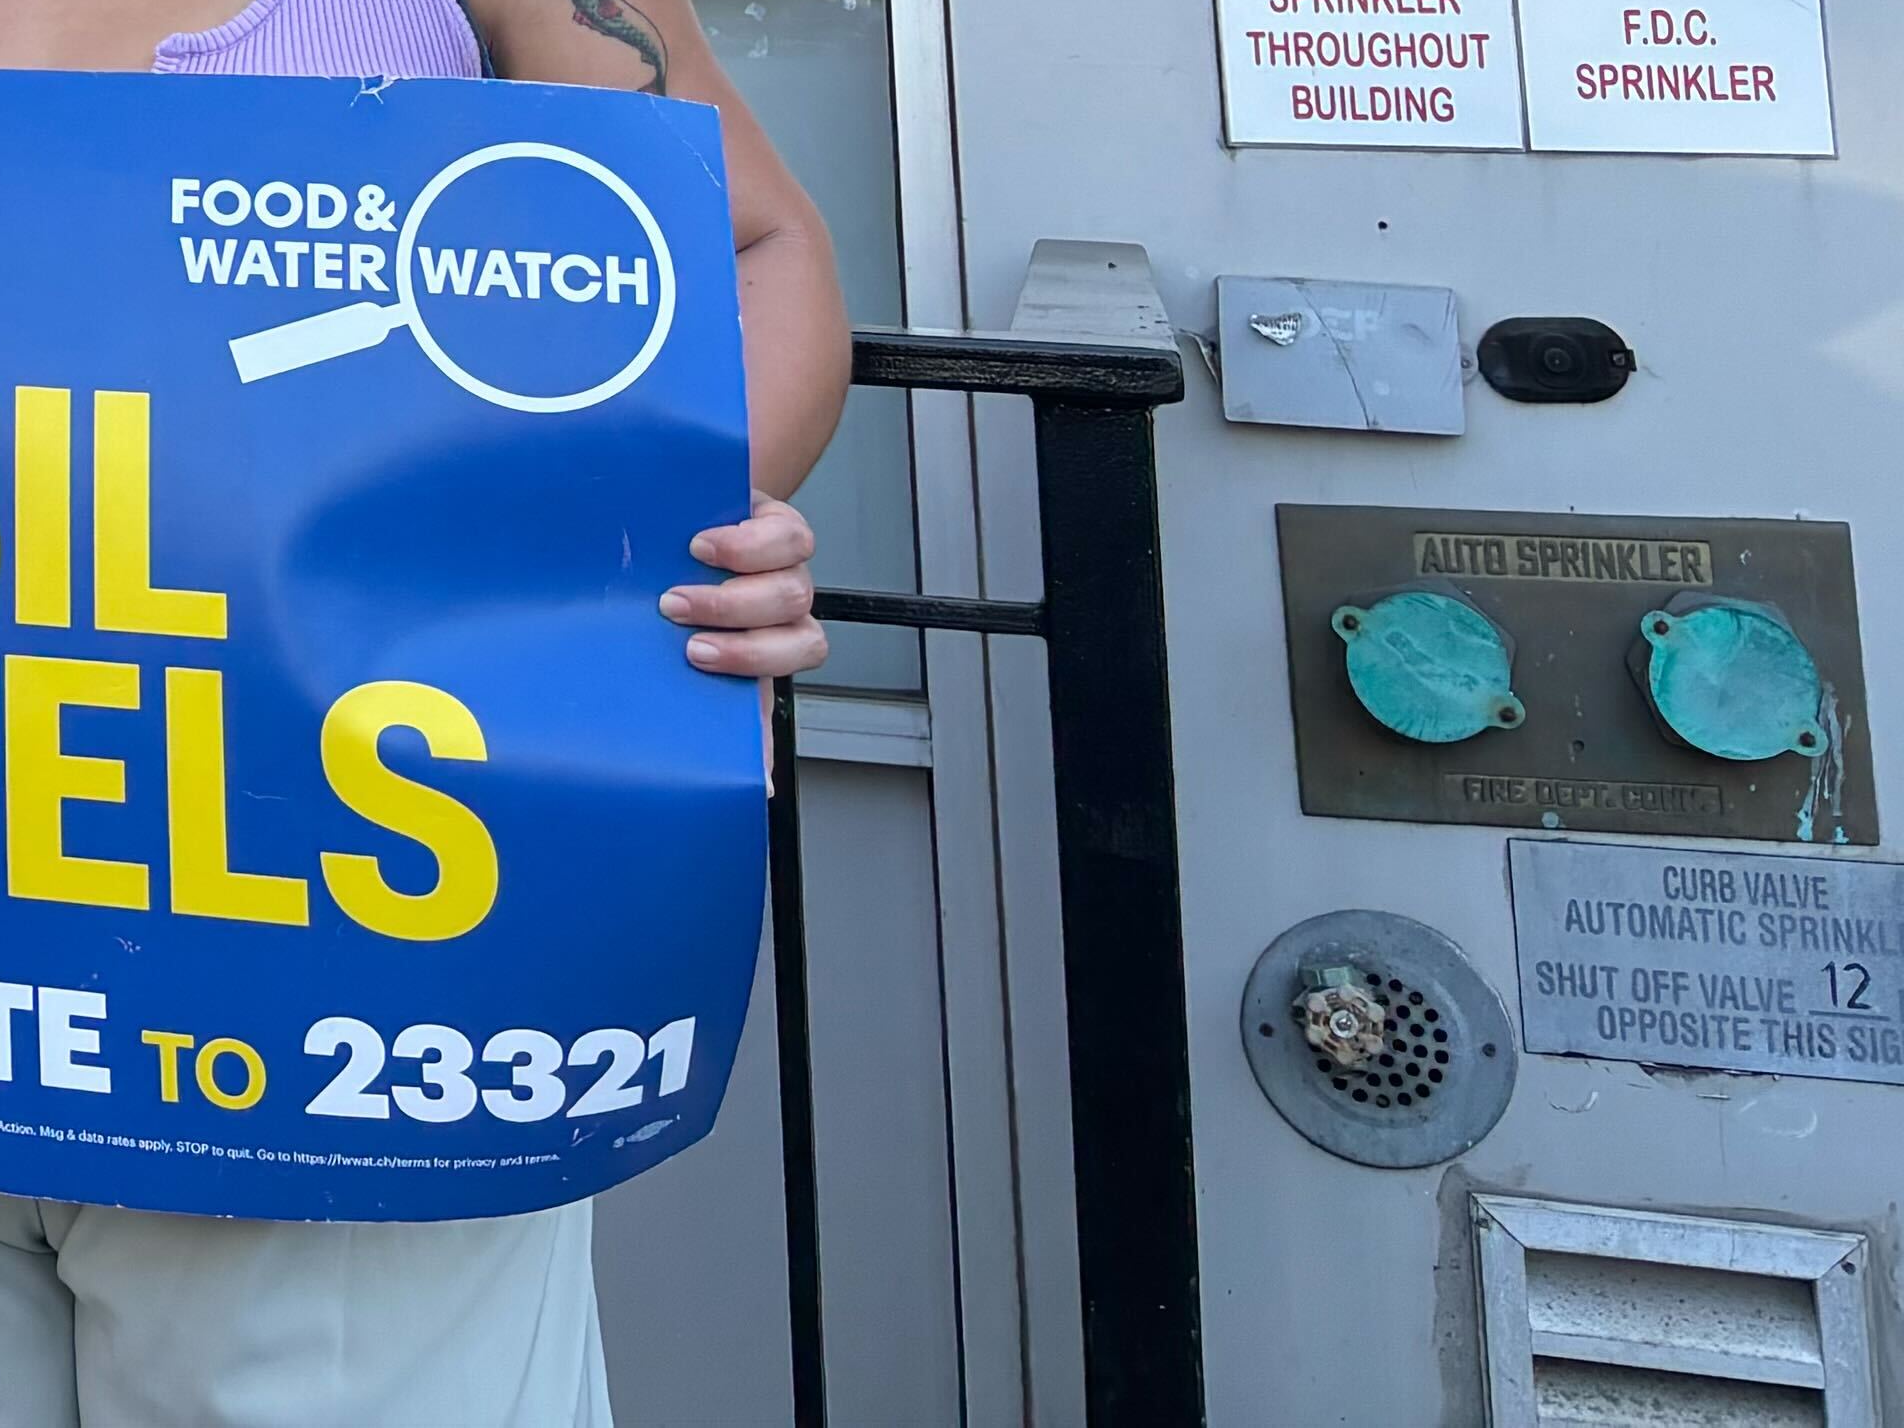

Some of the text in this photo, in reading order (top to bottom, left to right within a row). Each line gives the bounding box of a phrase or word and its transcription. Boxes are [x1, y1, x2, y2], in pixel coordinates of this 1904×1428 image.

[1246, 31, 1490, 70] THROUGHOUT
[1622, 9, 1717, 46] F.D.C.
[1291, 85, 1455, 123] BUILDING
[1576, 63, 1776, 102] SPRINKLER
[179, 236, 650, 306] WATER WATCH
[1421, 536, 1707, 583] AUTO SPRINKLER
[1463, 777, 1526, 804] FIRE
[1662, 865, 1830, 911] CURB VALVE
[1564, 898, 1747, 945] AUTOMATIC
[1535, 960, 1619, 1001] SHUT
[1630, 967, 1690, 1006] OFF
[1698, 973, 1797, 1014] VALVE
[1821, 960, 1873, 1011] 12
[1597, 1005, 1752, 1052] OPPOSITE
[1760, 1017, 1836, 1060] THIS
[140, 1030, 269, 1112] TO
[302, 1014, 697, 1123] 23321
[78, 1129, 104, 1144] data
[106, 1134, 136, 1148] rates
[176, 1140, 209, 1155] STOP
[212, 1146, 224, 1159] to
[256, 1148, 275, 1162] Go
[277, 1150, 291, 1163] to
[433, 1156, 450, 1169] for
[453, 1157, 496, 1171] privacy
